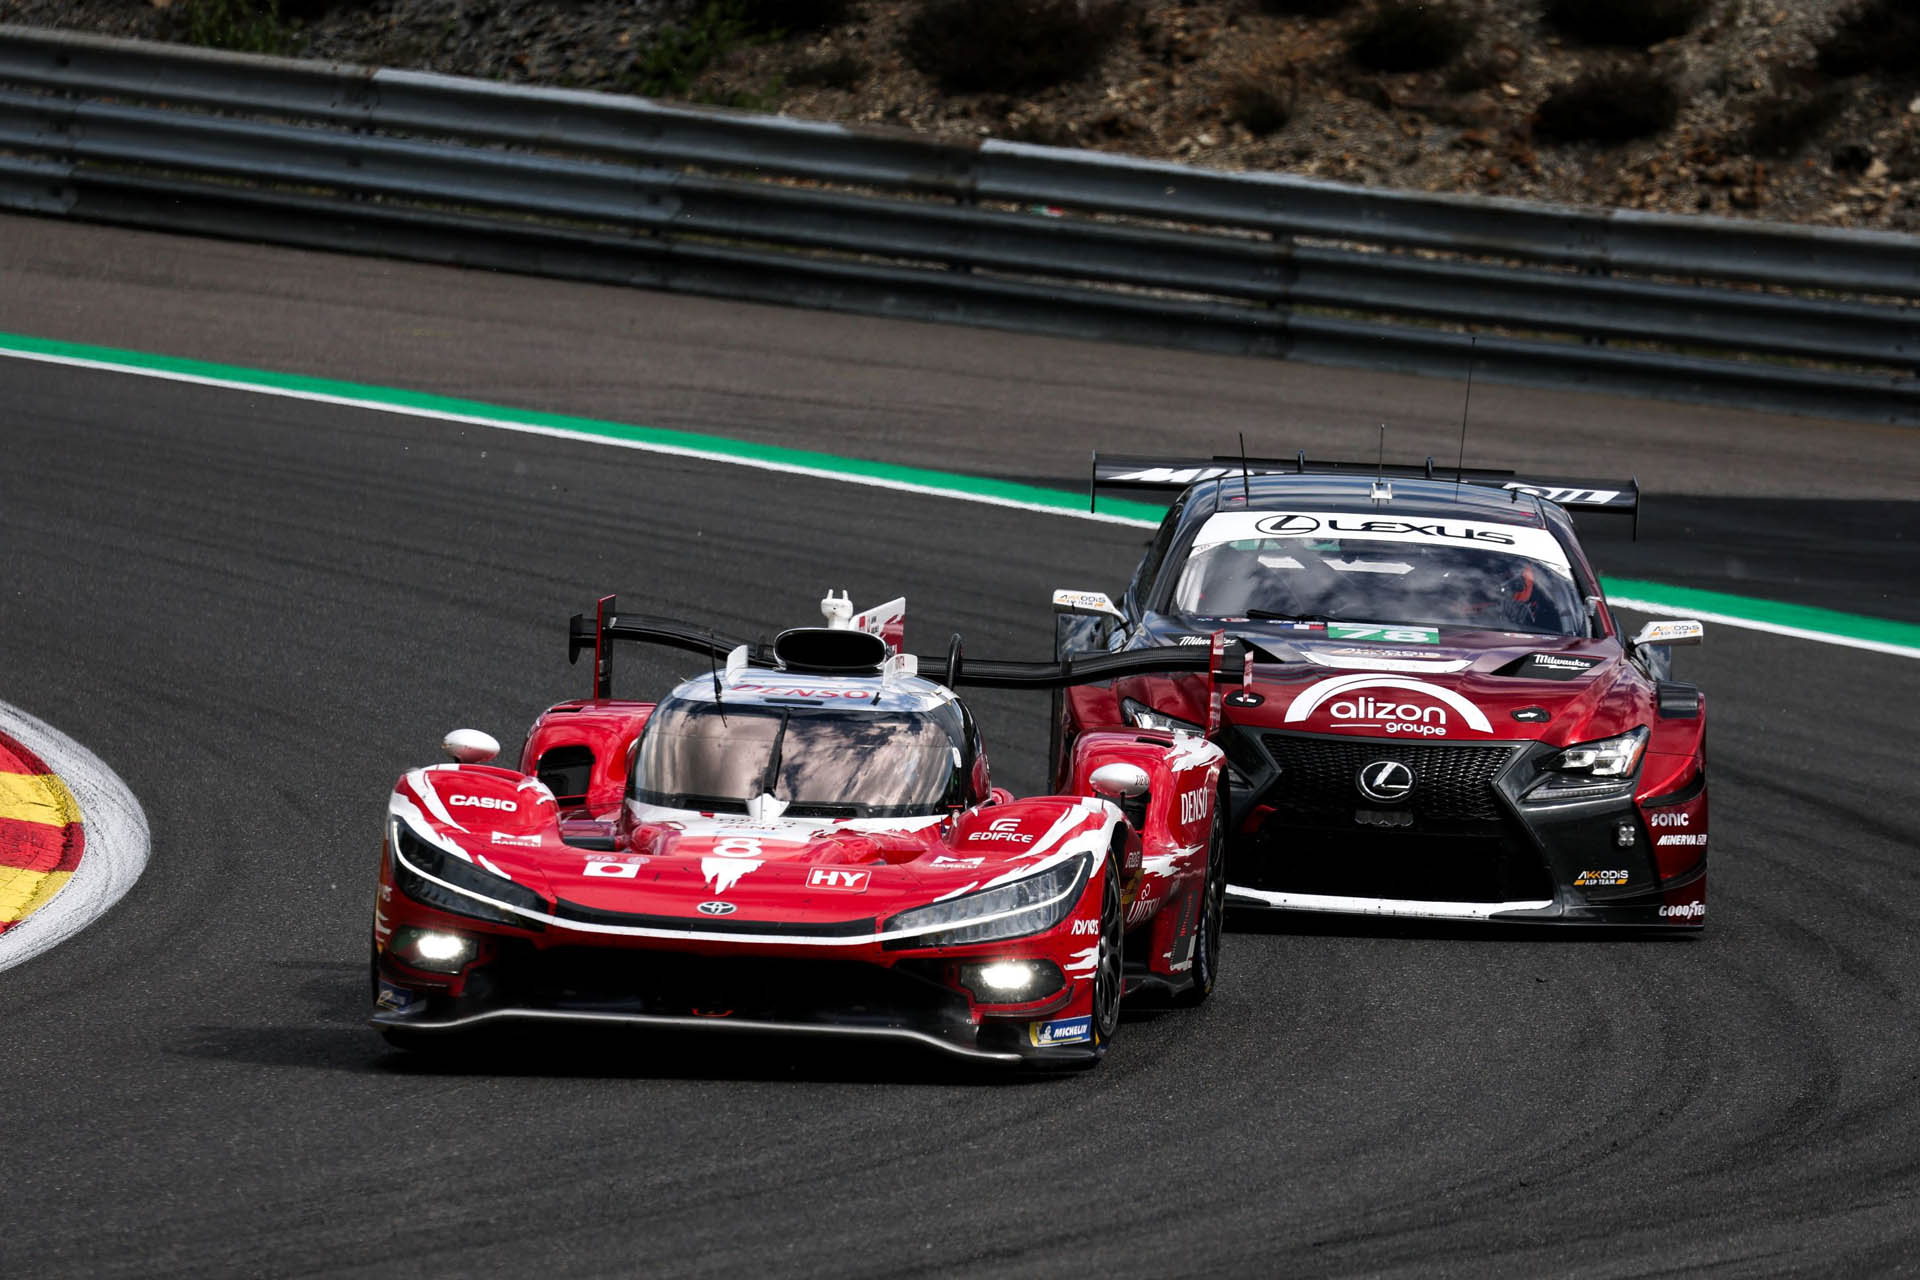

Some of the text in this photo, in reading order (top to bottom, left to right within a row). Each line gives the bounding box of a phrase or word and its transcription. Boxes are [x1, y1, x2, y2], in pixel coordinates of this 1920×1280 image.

[1328, 520, 1515, 545] LEXUS
[1337, 627, 1430, 642] 78
[1533, 653, 1592, 668] Milwaukee
[731, 684, 870, 699] DENSO
[1330, 697, 1446, 724] alizon
[1386, 721, 1447, 736] groupe
[449, 795, 517, 812] CASIO
[1180, 786, 1208, 825] DENSO
[968, 831, 1034, 843] EDIFICE
[712, 838, 762, 858] 8
[811, 870, 866, 887] HY
[1053, 1024, 1088, 1038] MICHELIN
